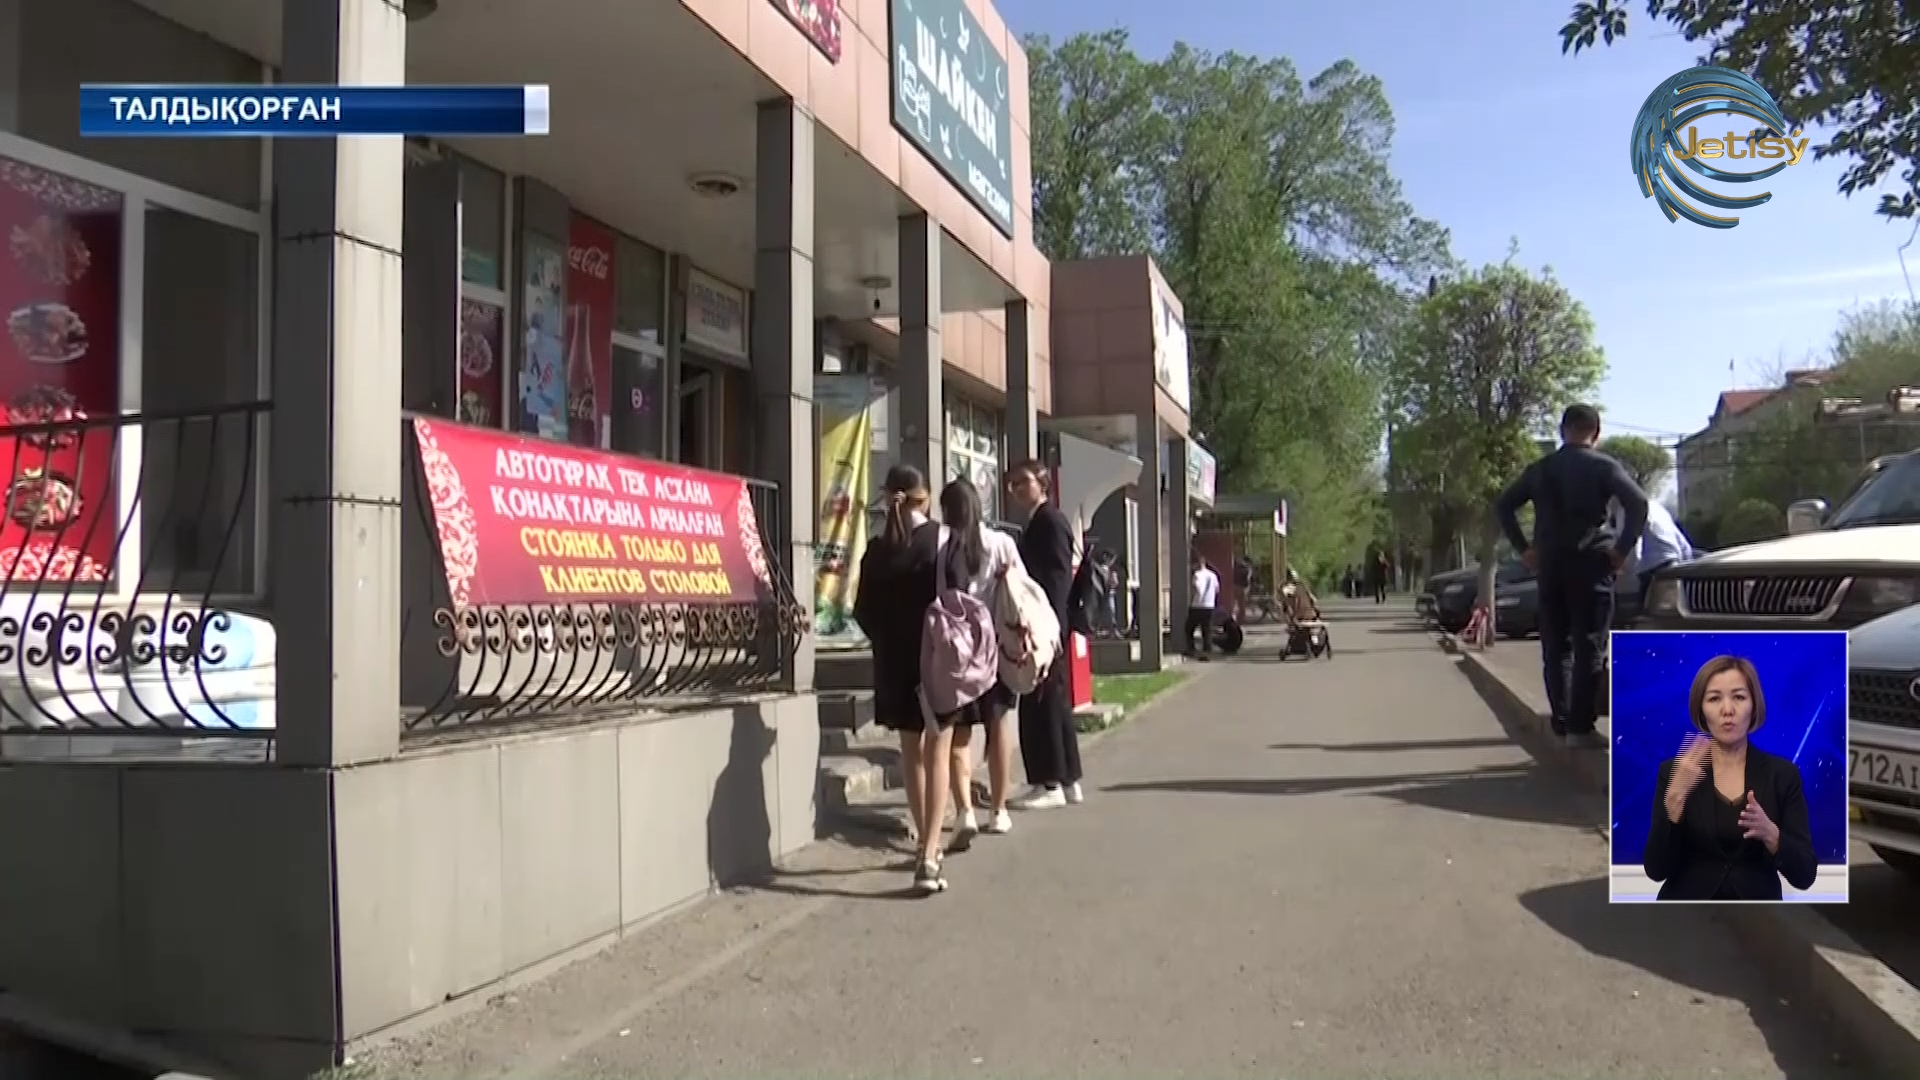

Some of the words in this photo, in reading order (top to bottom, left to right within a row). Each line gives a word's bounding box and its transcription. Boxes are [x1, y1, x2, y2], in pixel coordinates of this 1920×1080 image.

[916, 15, 997, 158] ШАЙКЕН
[495, 447, 614, 496] АВТОТҰРАҚ
[617, 468, 649, 497] ТЕК
[655, 477, 713, 507] АСХАНА
[489, 485, 645, 529] ҚОНАҚТАРЫНА
[650, 508, 725, 538] АРНАЛҒАН
[520, 526, 617, 560] СТОЯНКА
[620, 535, 687, 564] ТОЛЬКО
[692, 542, 722, 566] ДЛЯ
[539, 564, 646, 595] КЛИЕНТОВ
[649, 567, 732, 596] СТОЛОВОЙ
